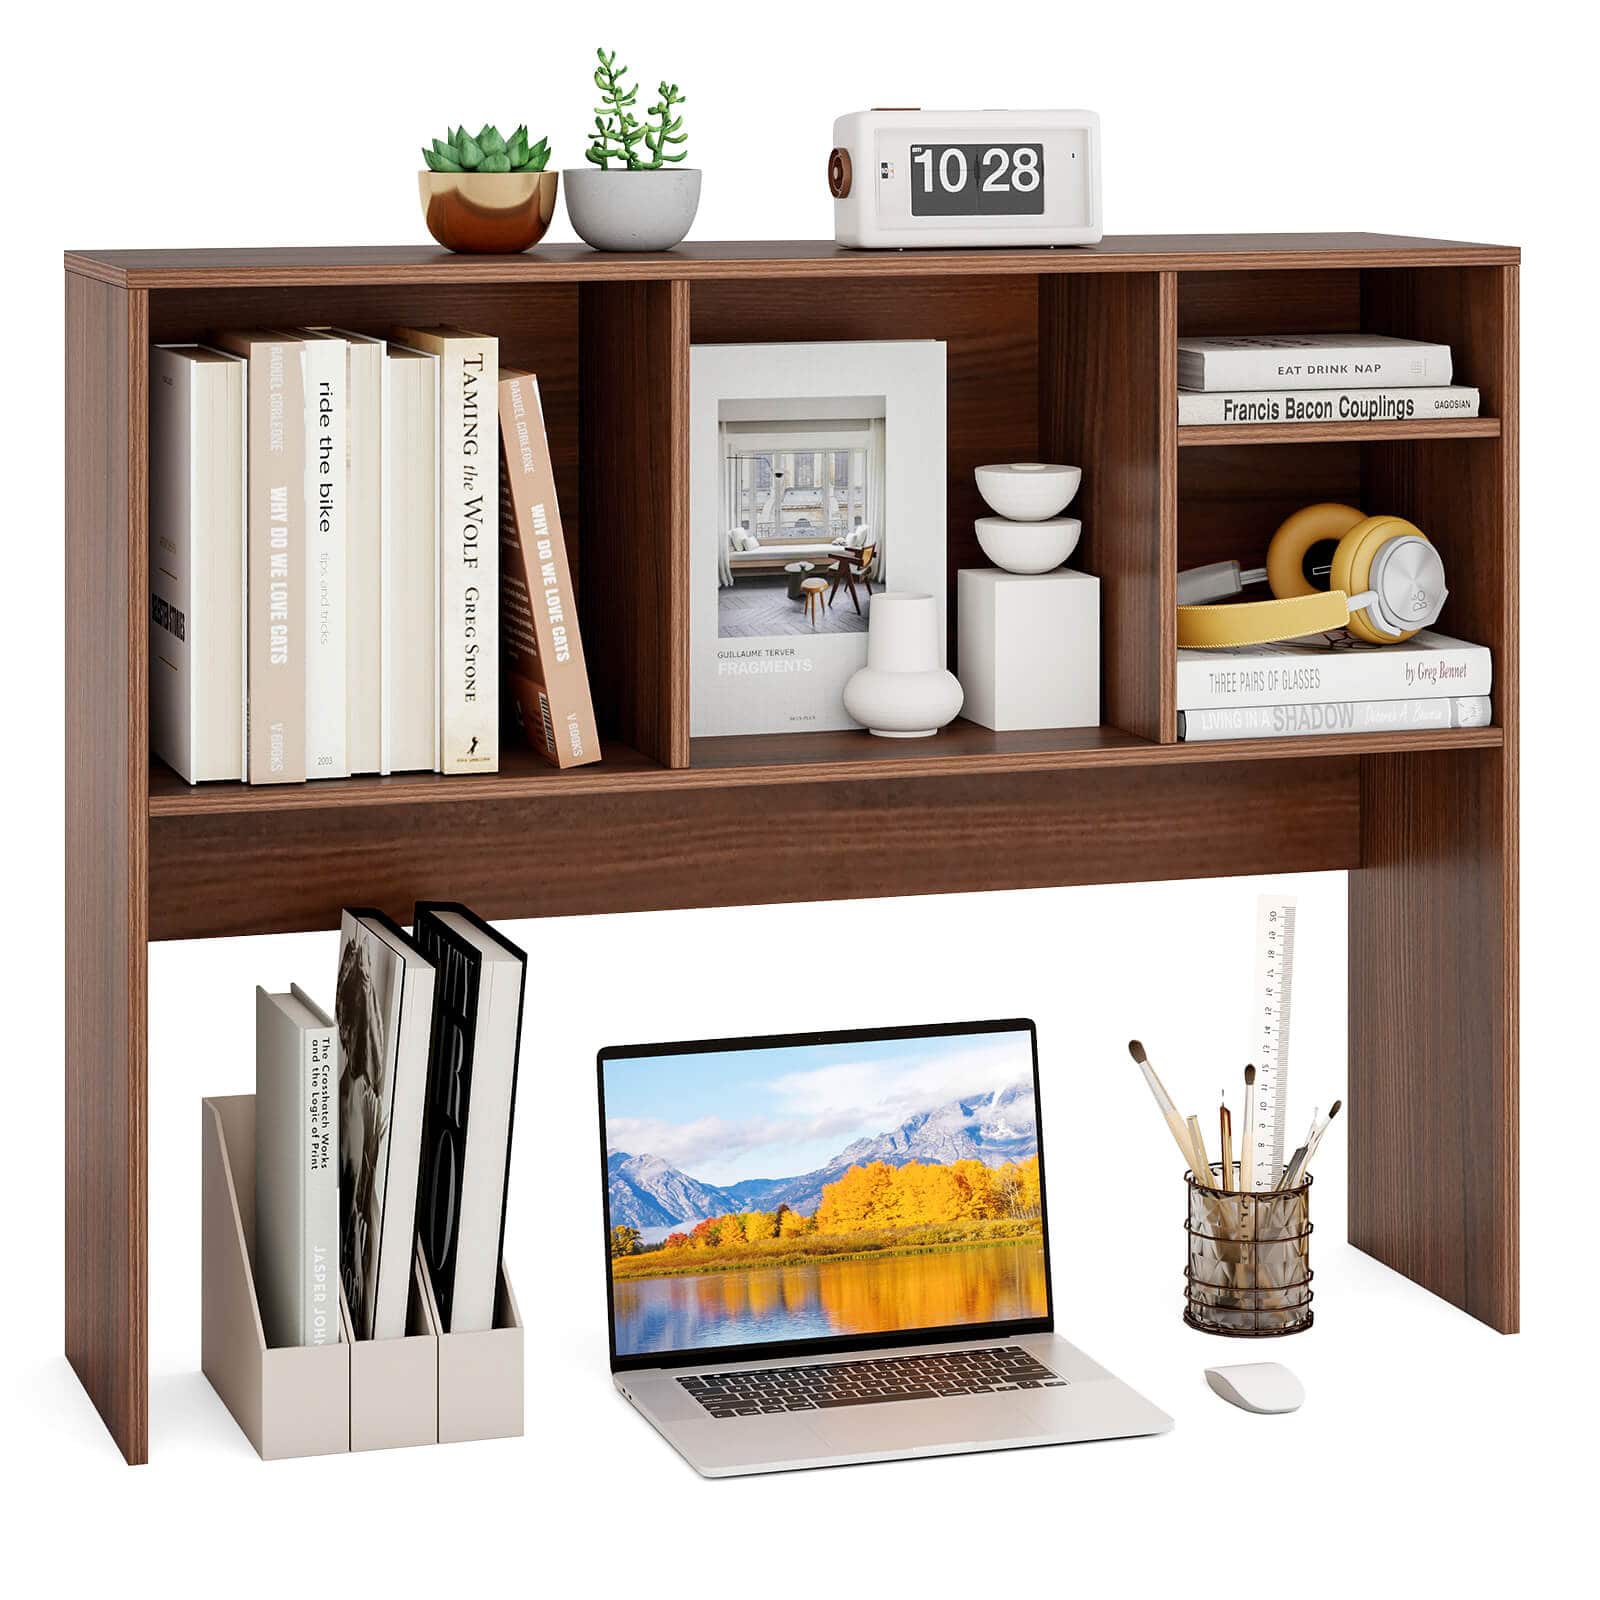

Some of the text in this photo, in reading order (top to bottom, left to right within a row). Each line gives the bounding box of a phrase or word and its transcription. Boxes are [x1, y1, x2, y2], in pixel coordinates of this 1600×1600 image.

[914, 148, 968, 193] 10
[982, 148, 1041, 192] 28
[1277, 364, 1382, 375] EAT DRINK NAP
[1224, 395, 1414, 422] Francis Bacon Couplings
[1434, 400, 1471, 410] GAGOSIAN
[319, 382, 333, 533] ride the bike
[463, 353, 483, 569] TAMING the WOLF
[516, 422, 535, 475] CORLEONE
[270, 486, 288, 665] WHY DO WE LOVE CATS
[319, 580, 330, 607] and
[530, 503, 570, 664] WHY DO WE LOVE CATS
[319, 610, 330, 646] tricks
[464, 586, 480, 704] GREG STONE
[717, 648, 796, 659] GUILLAUME TERVER
[718, 658, 814, 675] FRAGMENTS
[1405, 661, 1467, 687] by Greg Bennet
[1209, 668, 1321, 693] THREE PAIRS OF GLASSES
[567, 712, 584, 758] V BOOKS
[1201, 710, 1241, 730] LIVING
[1245, 711, 1259, 729] IN
[1260, 710, 1272, 729] A
[1272, 701, 1354, 732] SHADOW
[309, 1039, 321, 1170] and the Logic of Print
[321, 1037, 330, 1169] The Crosshatch Works
[313, 1245, 327, 1303] JASPER
